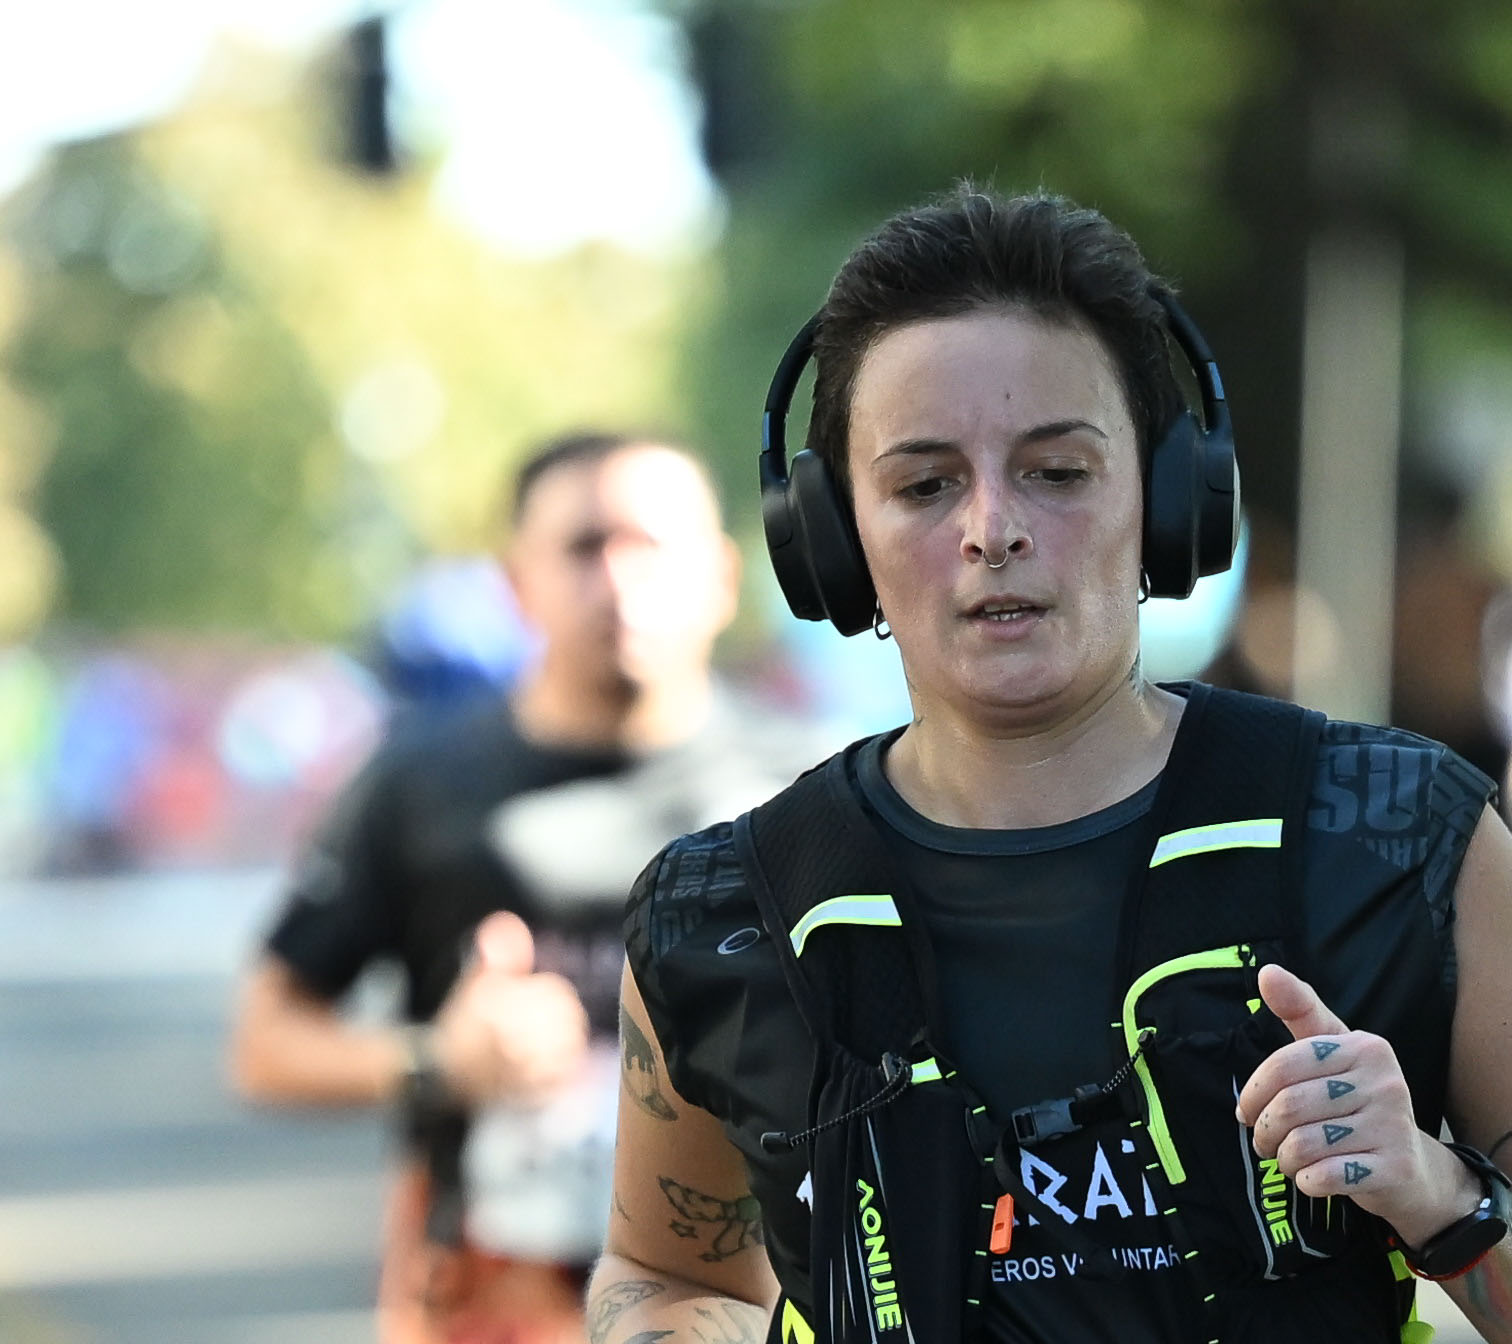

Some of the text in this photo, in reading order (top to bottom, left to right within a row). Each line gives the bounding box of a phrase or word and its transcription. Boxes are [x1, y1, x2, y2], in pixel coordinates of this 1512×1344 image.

[1258, 1158, 1294, 1247] NIJIE
[856, 1178, 902, 1333] AONIJIE
[991, 1255, 1057, 1283] EROS
